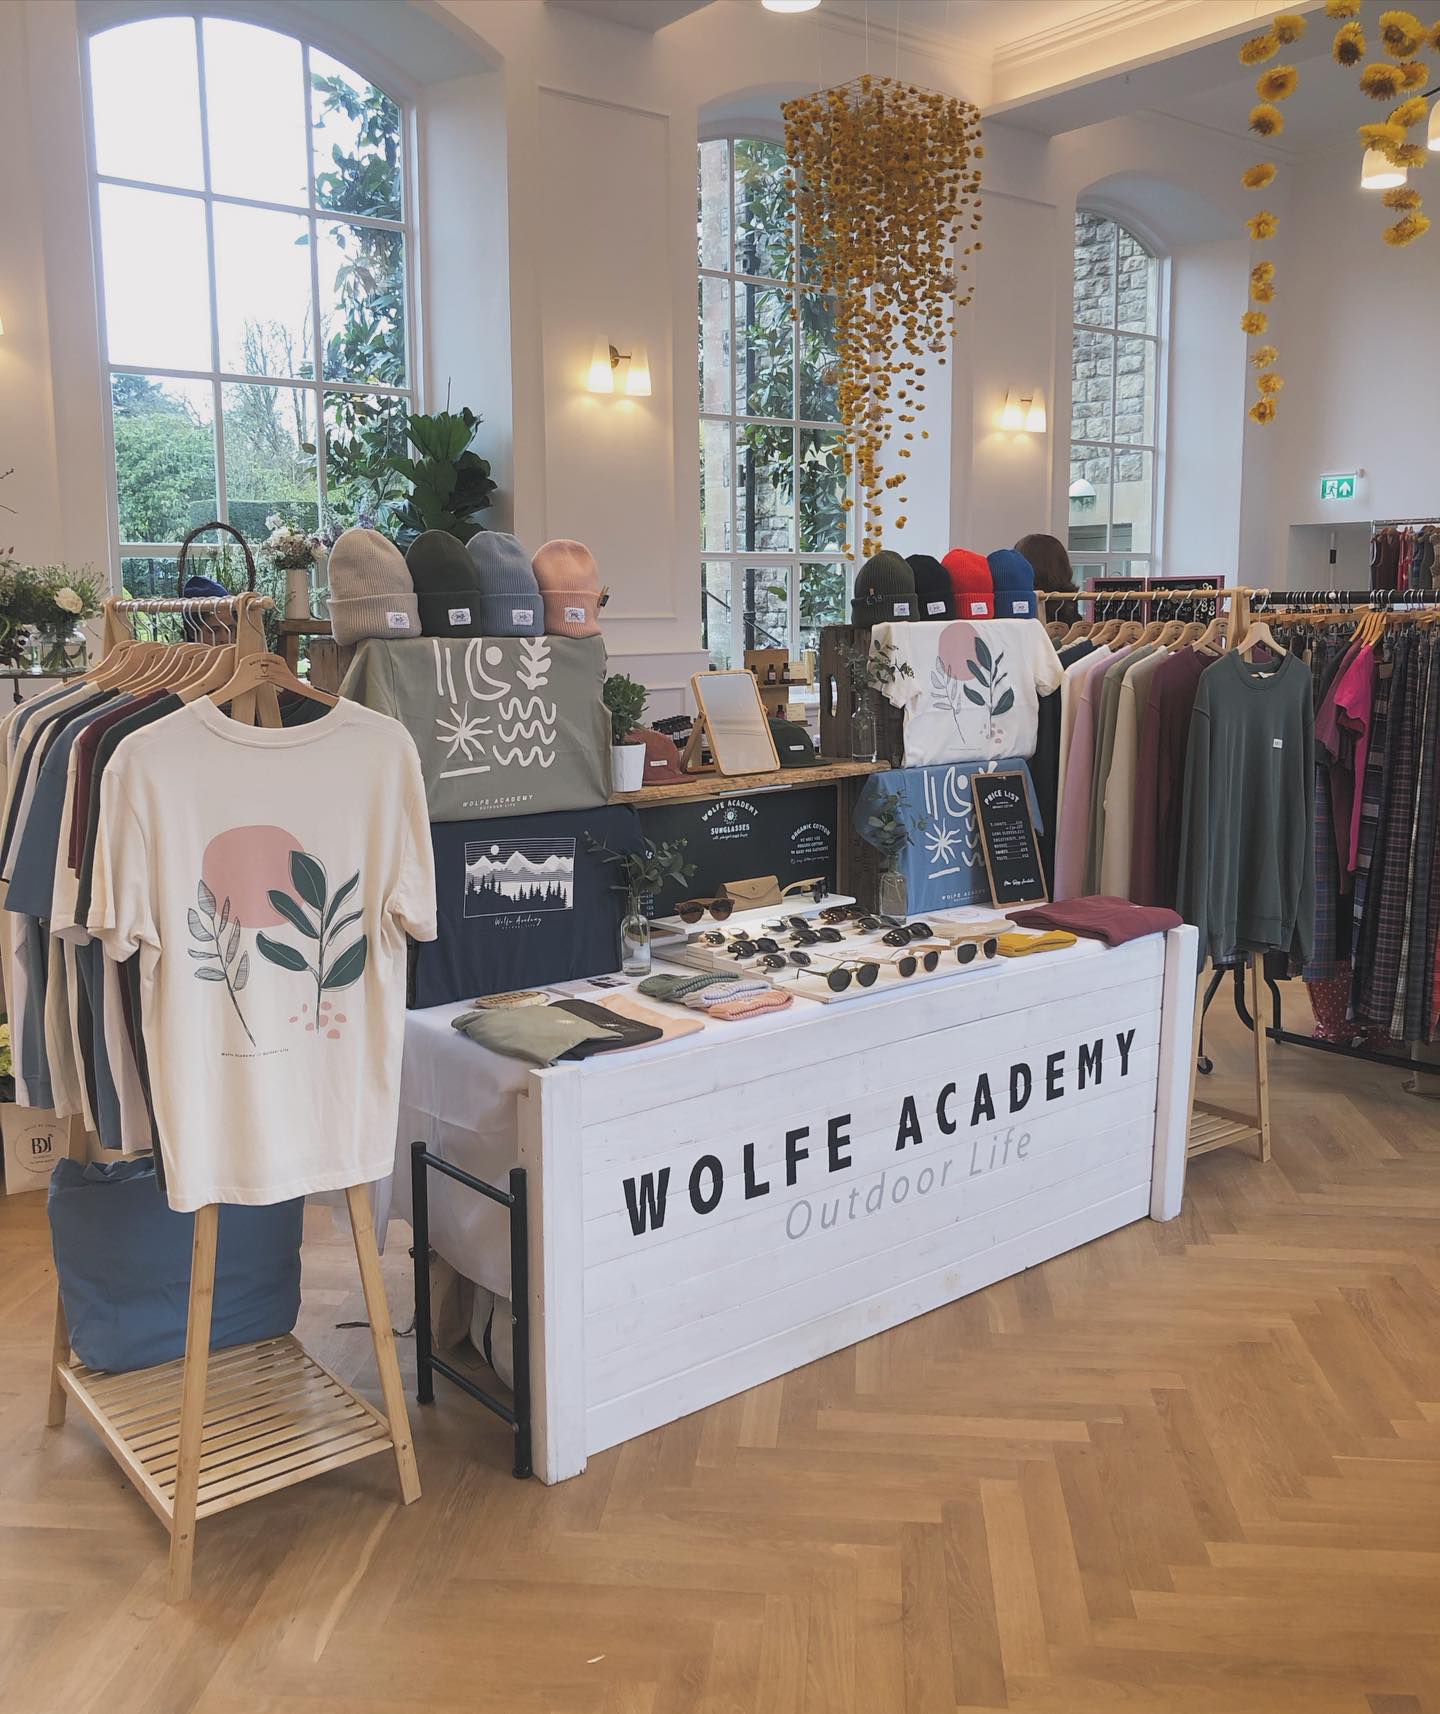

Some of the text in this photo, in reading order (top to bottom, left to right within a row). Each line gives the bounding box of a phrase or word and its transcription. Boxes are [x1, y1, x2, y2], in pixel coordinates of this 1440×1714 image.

[462, 799, 489, 807] WOLFE
[494, 794, 533, 804] ACADEMY
[984, 789, 1020, 805] PRICE LIST
[701, 799, 759, 821] WOLFE ACADEMY
[710, 823, 750, 835] SUNGLASSES
[622, 1028, 1136, 1236] WOLFE ACADEMY
[785, 1128, 1033, 1241] Outdoor Life
